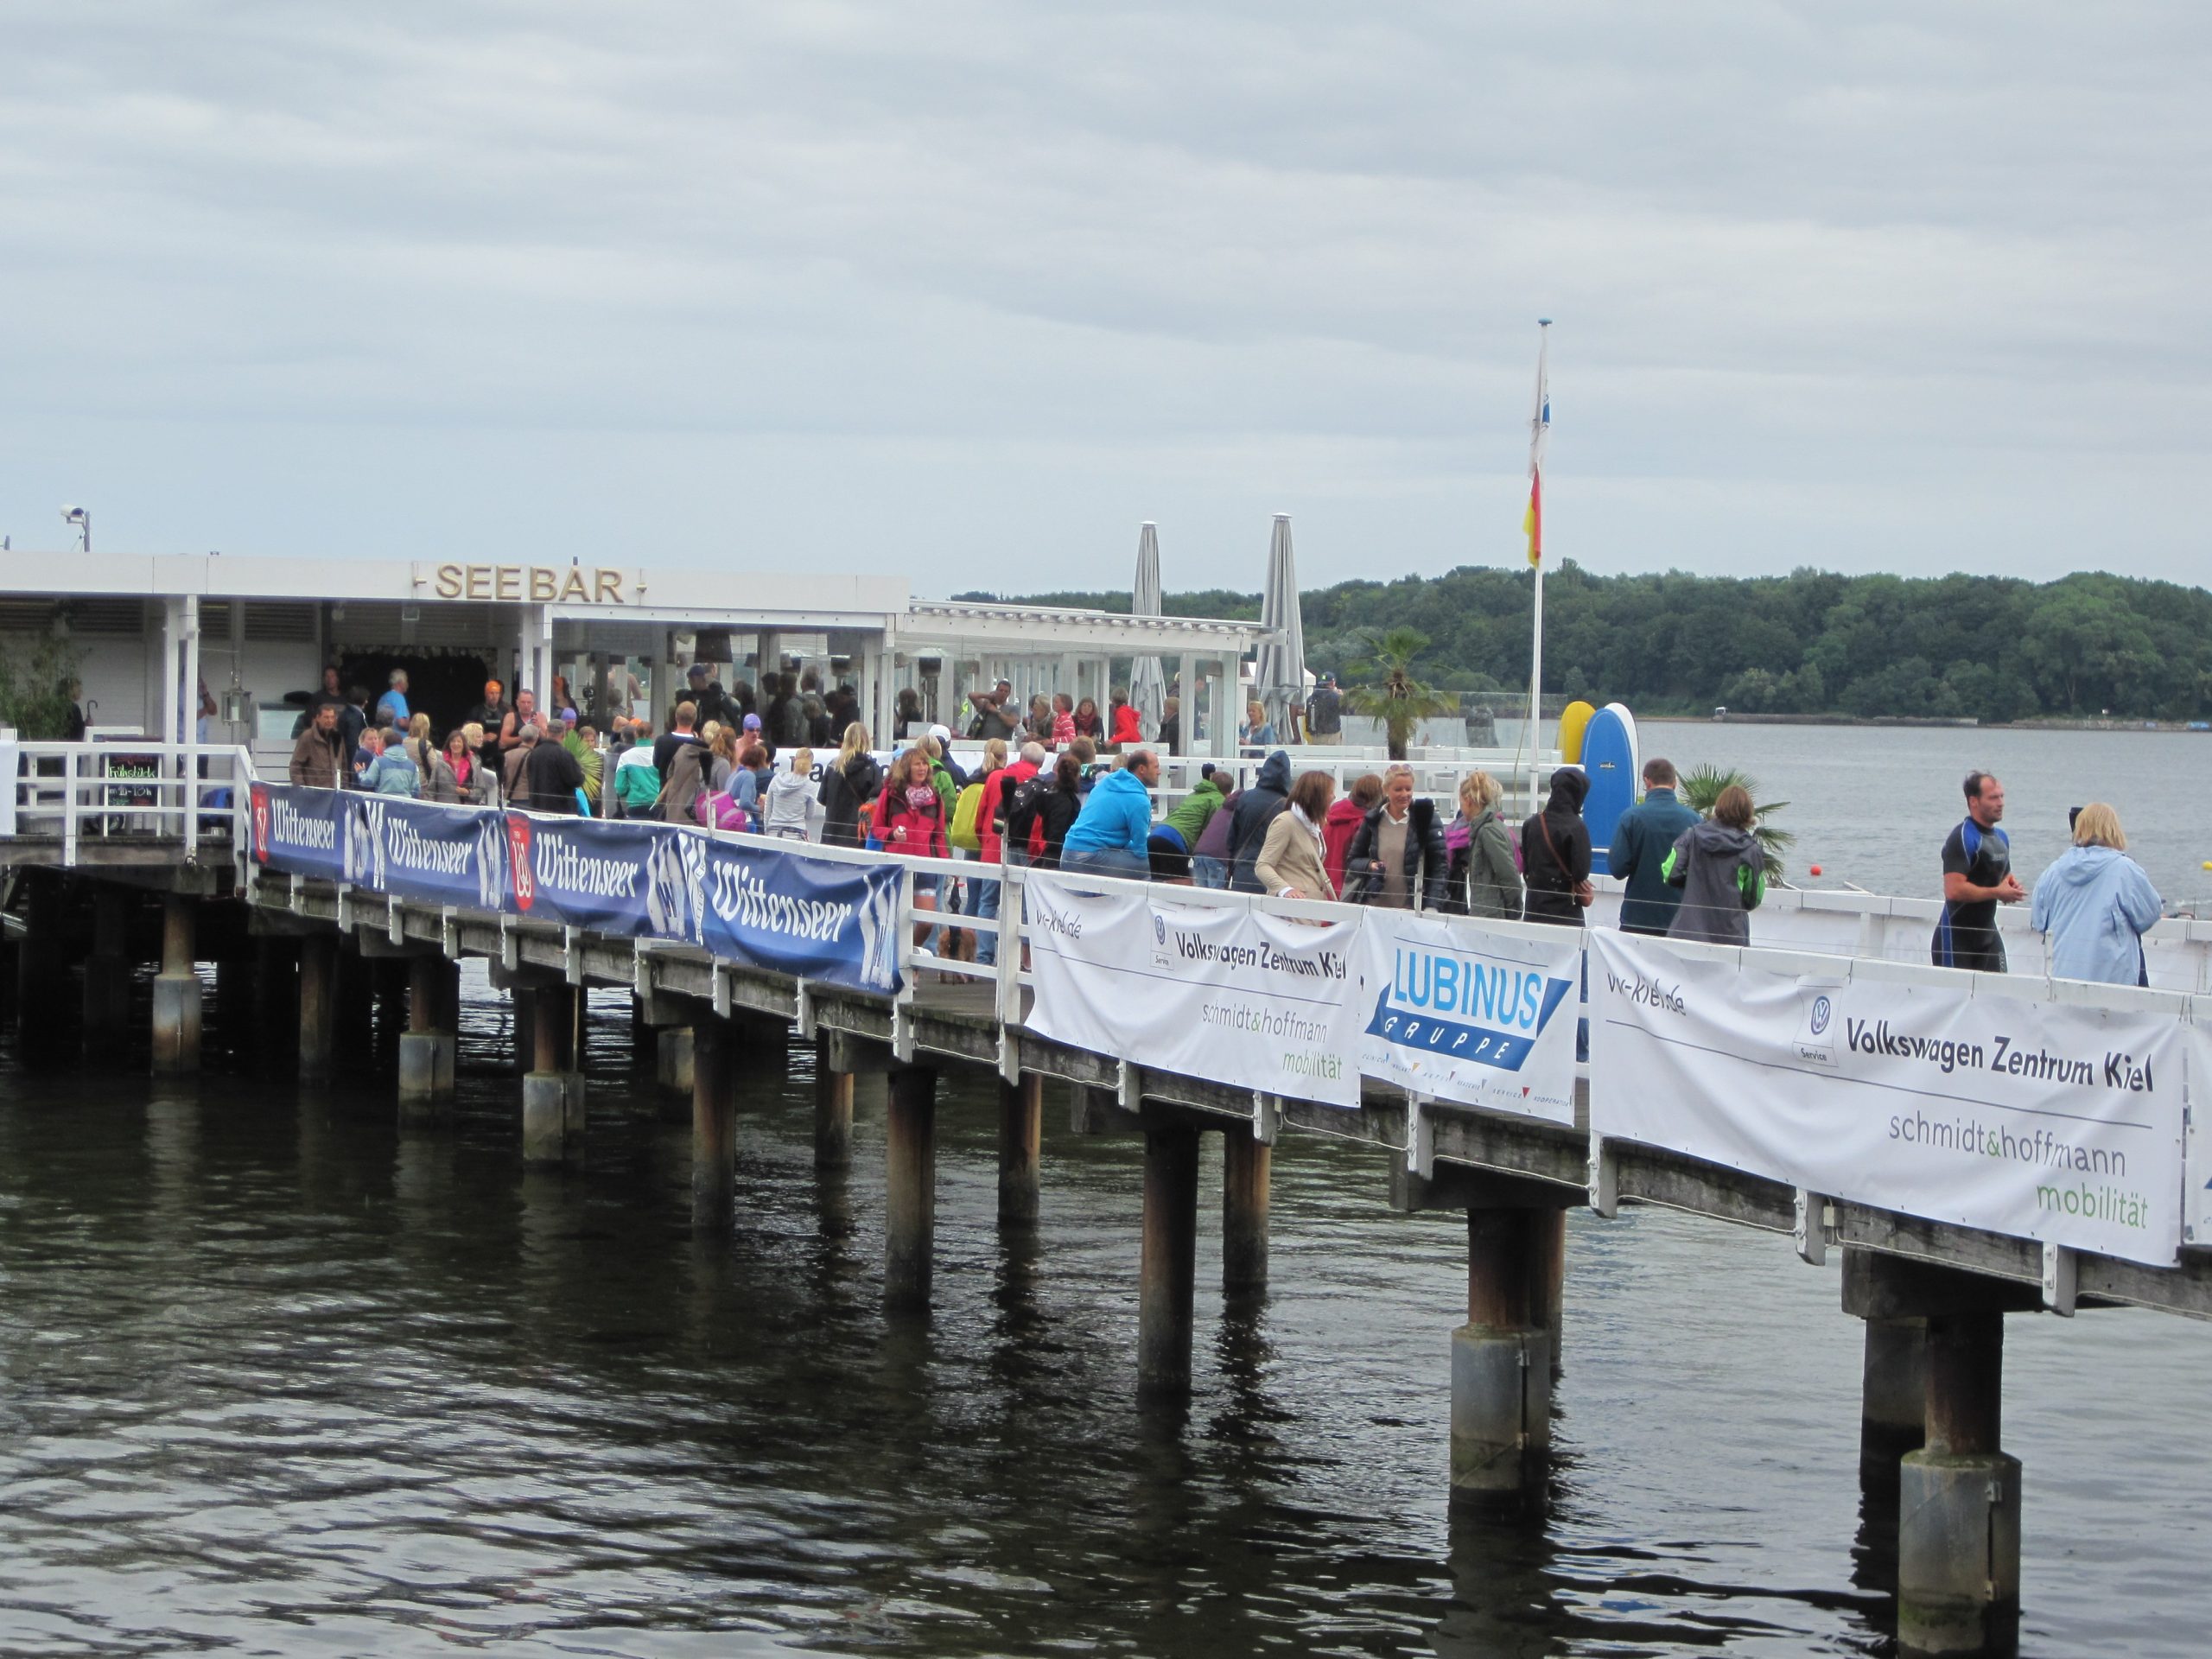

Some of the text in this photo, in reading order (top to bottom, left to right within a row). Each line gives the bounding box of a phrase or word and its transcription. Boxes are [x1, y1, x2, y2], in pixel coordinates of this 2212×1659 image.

[271, 798, 335, 850] Wittenseer
[387, 817, 473, 875] Wittenseer
[537, 831, 638, 899] Wittenseer
[712, 860, 852, 944] Wittenseer
[1175, 931, 1256, 970] Volkswagen
[1260, 942, 1319, 977] Zentrum
[1394, 948, 1542, 1030] LUBINUS
[1202, 1002, 1328, 1042] schmidt&hoffmann
[1384, 1016, 1511, 1060] GRUPPE
[1282, 1049, 1343, 1080] mobilität
[1800, 1047, 1827, 1061] Service
[1847, 1018, 2153, 1091] Volkswagen Zentrum Kiel
[1890, 1109, 2126, 1178] schmidt&hoffmann
[2037, 1182, 2149, 1229] mobilität
